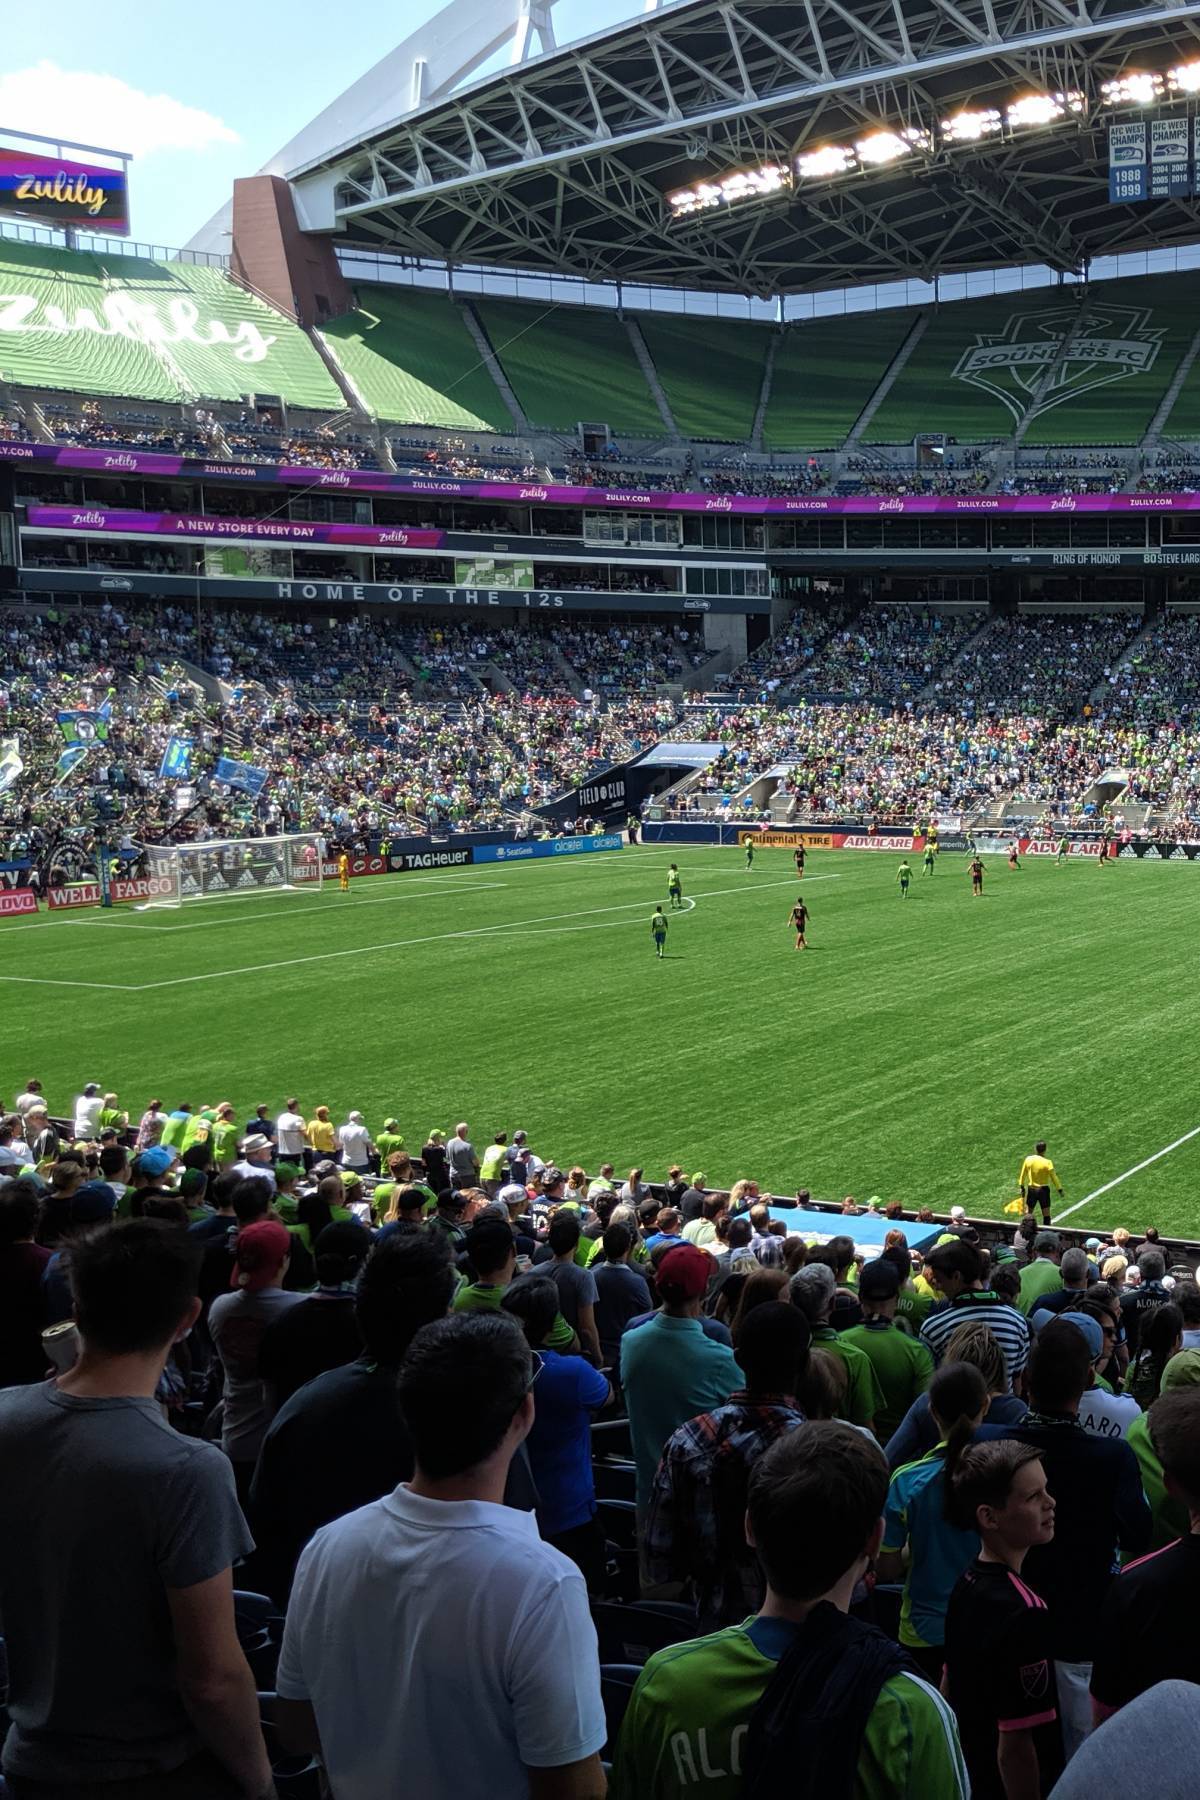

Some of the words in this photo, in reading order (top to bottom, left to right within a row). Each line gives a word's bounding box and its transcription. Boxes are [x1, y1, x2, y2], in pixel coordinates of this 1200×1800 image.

[1111, 126, 1123, 136] AFC
[1125, 124, 1145, 134] WEST
[1152, 122, 1166, 131] NFC
[1168, 119, 1188, 128] WEST
[1110, 133, 1145, 146] CHAMPS
[1152, 129, 1188, 142] CHAMPS
[1115, 169, 1141, 183] 1988
[1115, 183, 1141, 197] 1999
[1114, 349, 1146, 362] FC
[204, 464, 257, 477] ZULILY.COM
[412, 481, 461, 492] ZULILY.COM
[606, 494, 651, 504] ZULILY.COM
[1129, 499, 1173, 507] ZULILY.COM
[176, 519, 185, 530] A
[188, 520, 214, 531] NEW
[218, 523, 254, 533] STORE
[257, 525, 290, 535] EVERY
[293, 527, 315, 537] DAY
[1053, 554, 1075, 564] RING
[1078, 554, 1088, 564] OF
[1092, 554, 1121, 564] HONOR
[1143, 554, 1157, 564] 80
[1157, 555, 1179, 564] STEVE
[278, 583, 365, 600] HOME
[388, 588, 424, 602] OF
[446, 589, 500, 605] THE
[523, 593, 564, 607] 12s
[579, 787, 600, 807] FIELD
[608, 781, 625, 800] CLUB
[808, 836, 830, 845] TIRE
[843, 836, 912, 849] ADVOCARE
[52, 886, 101, 905] WELL
[116, 878, 171, 897] FARGO
[1136, 1299, 1162, 1309] ALONS
